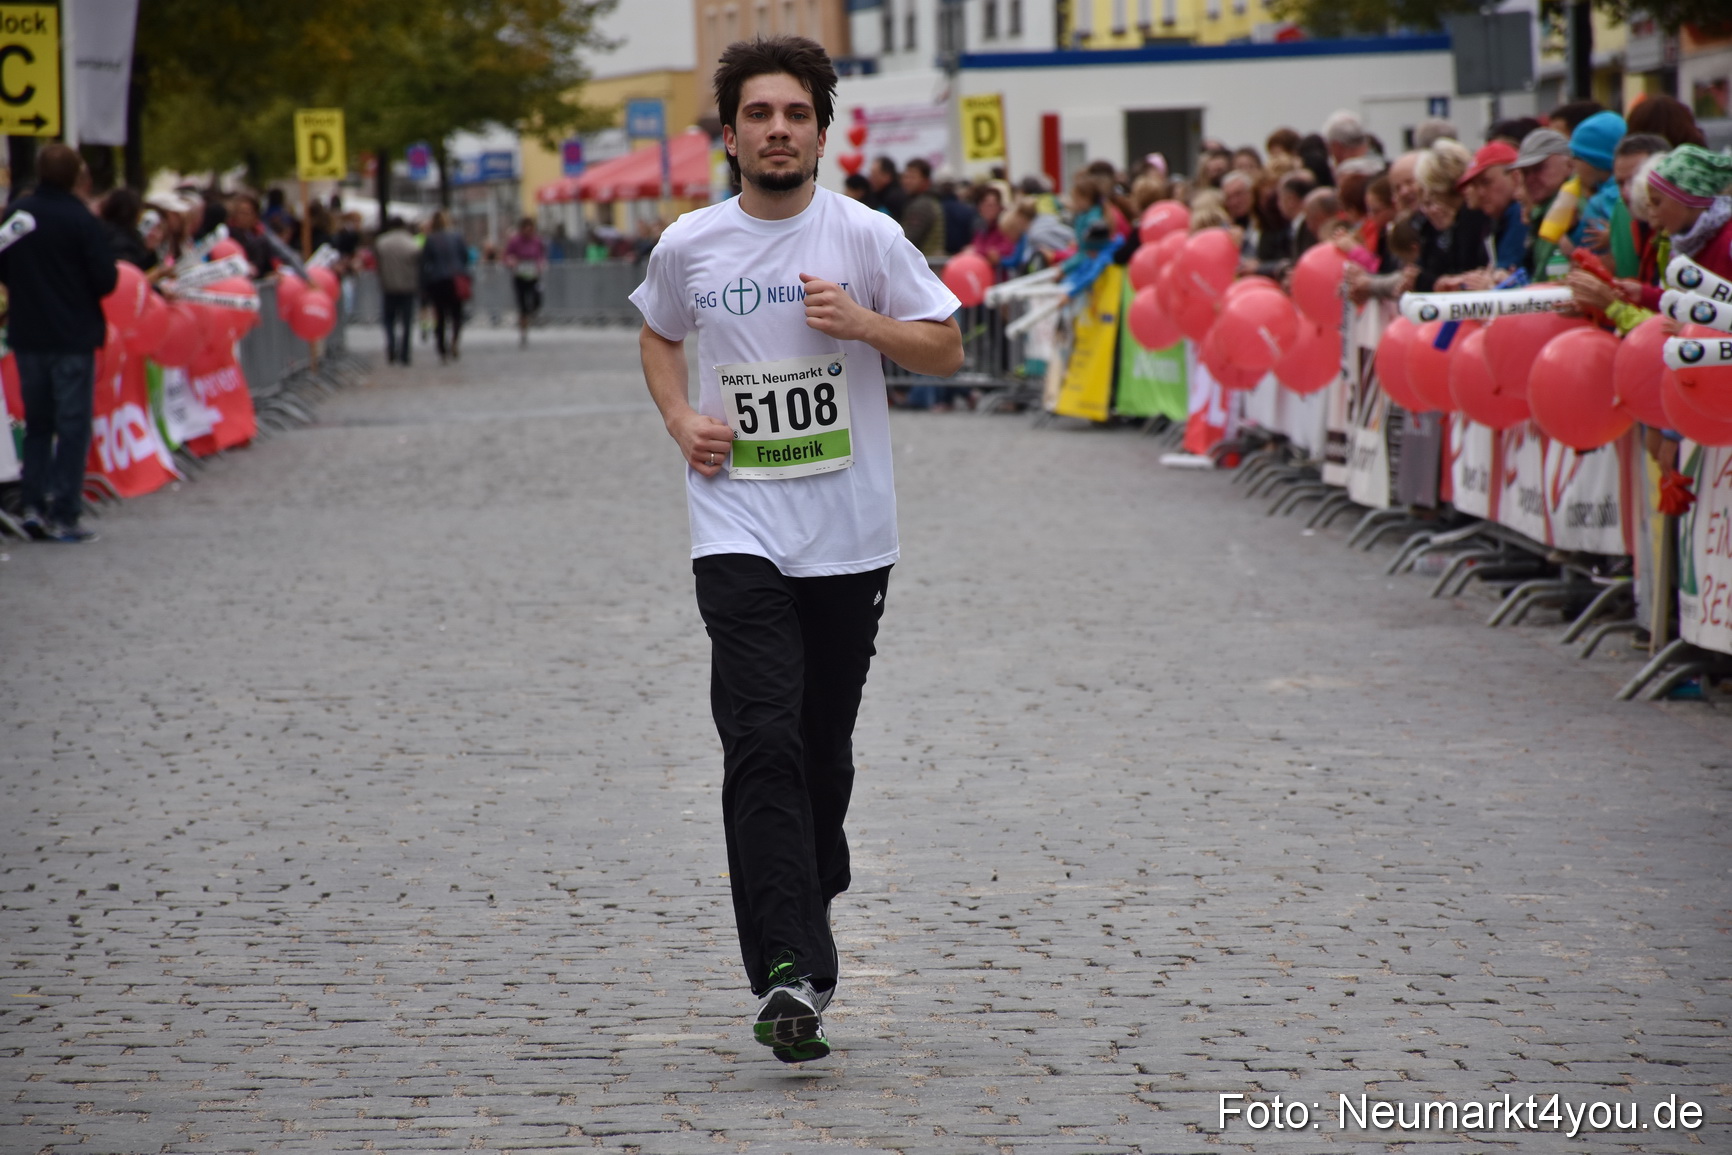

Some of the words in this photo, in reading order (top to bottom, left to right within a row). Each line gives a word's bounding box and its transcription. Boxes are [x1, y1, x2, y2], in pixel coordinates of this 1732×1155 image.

[0, 44, 36, 107] C
[972, 112, 997, 148] D
[309, 131, 333, 165] D
[694, 291, 717, 309] FeG
[767, 283, 849, 303] NEUMT
[1450, 301, 1492, 320] BMW
[721, 374, 760, 386] PARTL
[762, 367, 823, 384] Neumarkt
[735, 382, 838, 434] 5108
[756, 440, 824, 463] Frederik
